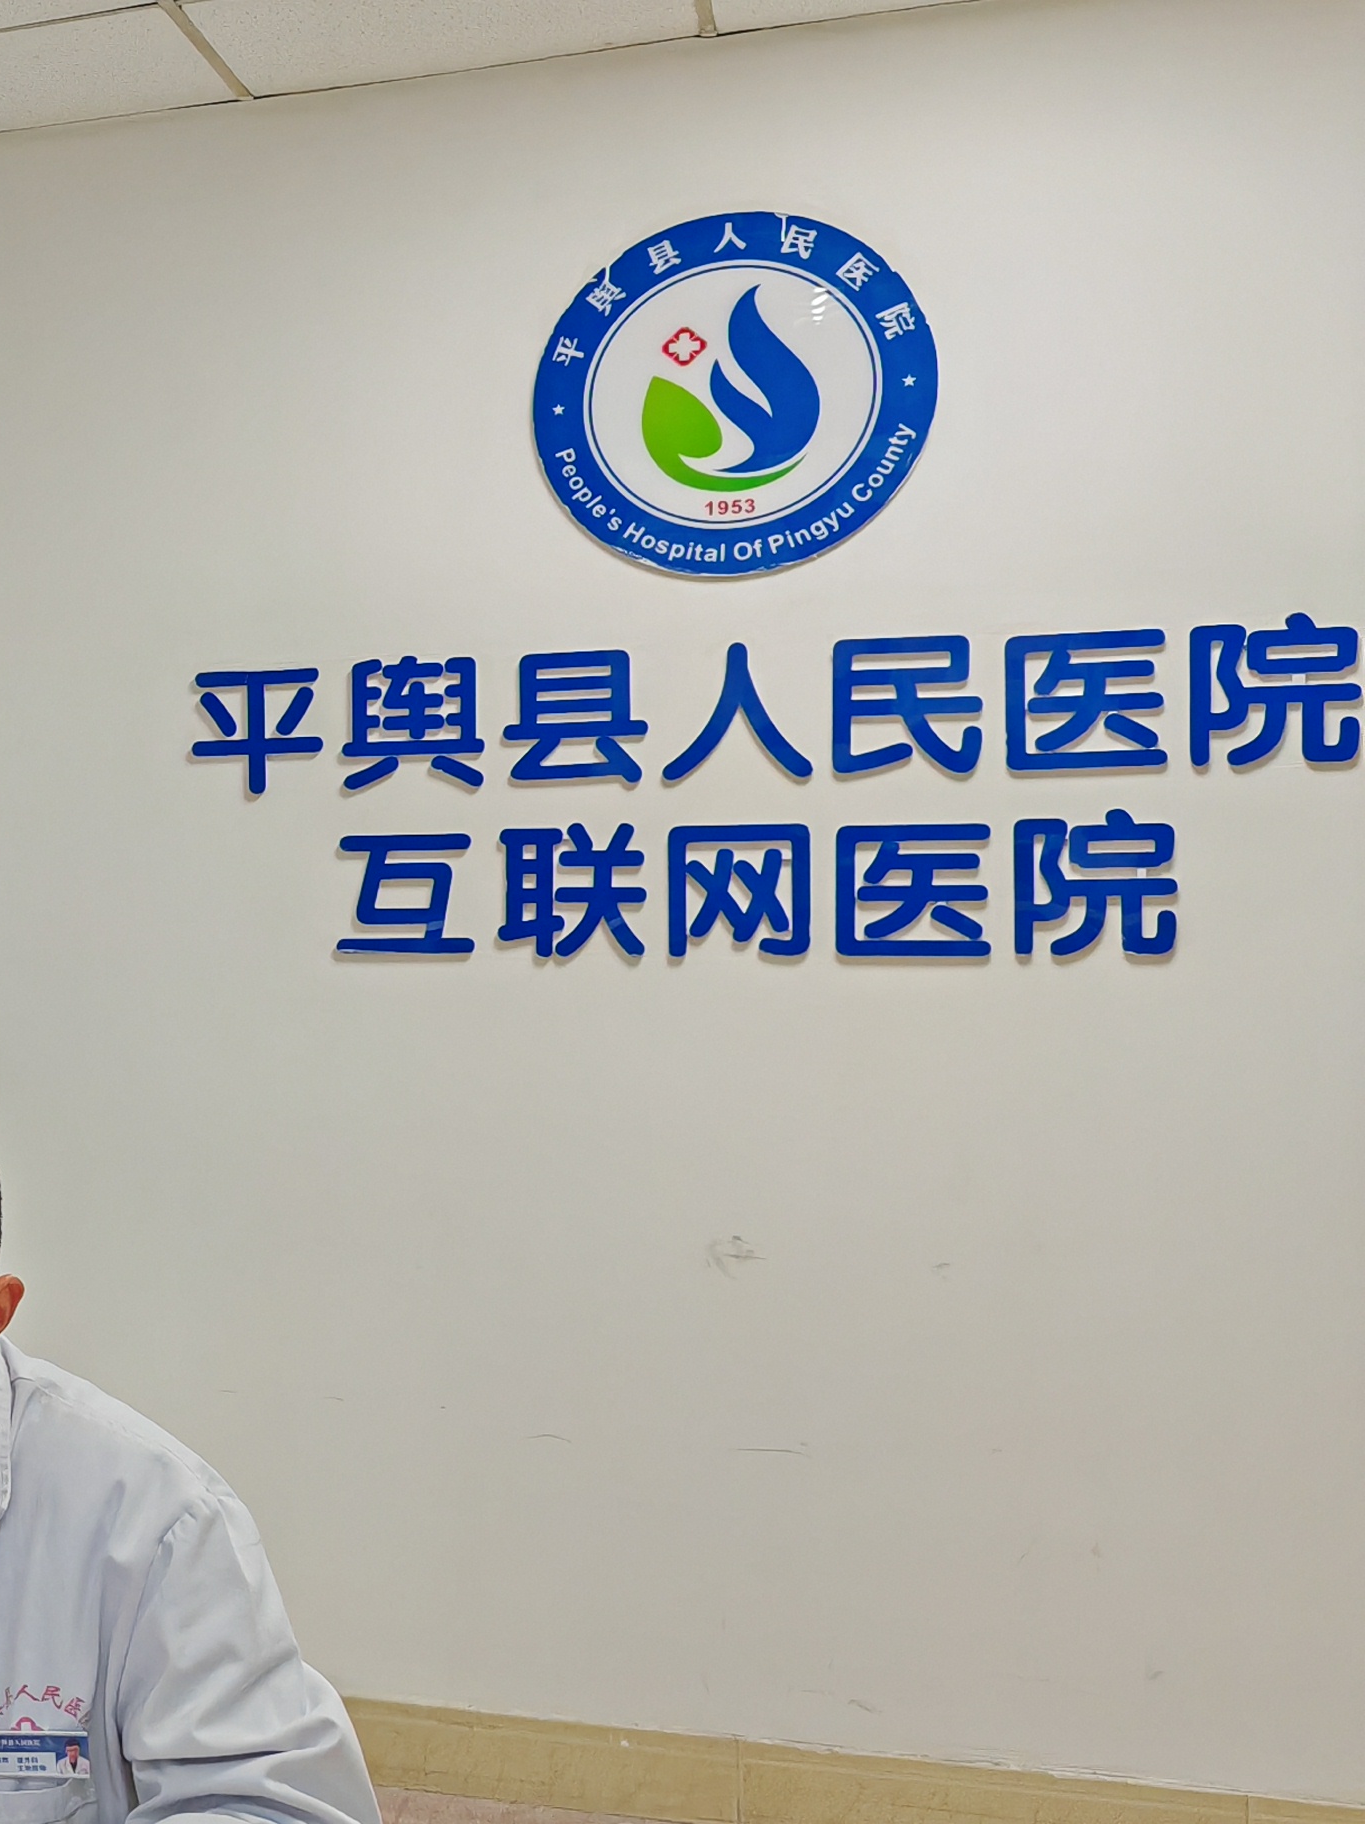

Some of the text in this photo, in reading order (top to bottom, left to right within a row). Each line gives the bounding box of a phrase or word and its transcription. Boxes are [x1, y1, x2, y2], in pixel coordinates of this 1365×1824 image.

[552, 222, 916, 366] 平舆县人民医院
[555, 422, 917, 563] People's Hospital Of Pingyu County
[704, 498, 756, 516] 1953
[193, 613, 1361, 794] 平舆县人民医院
[337, 809, 1177, 957] 互联网医院
